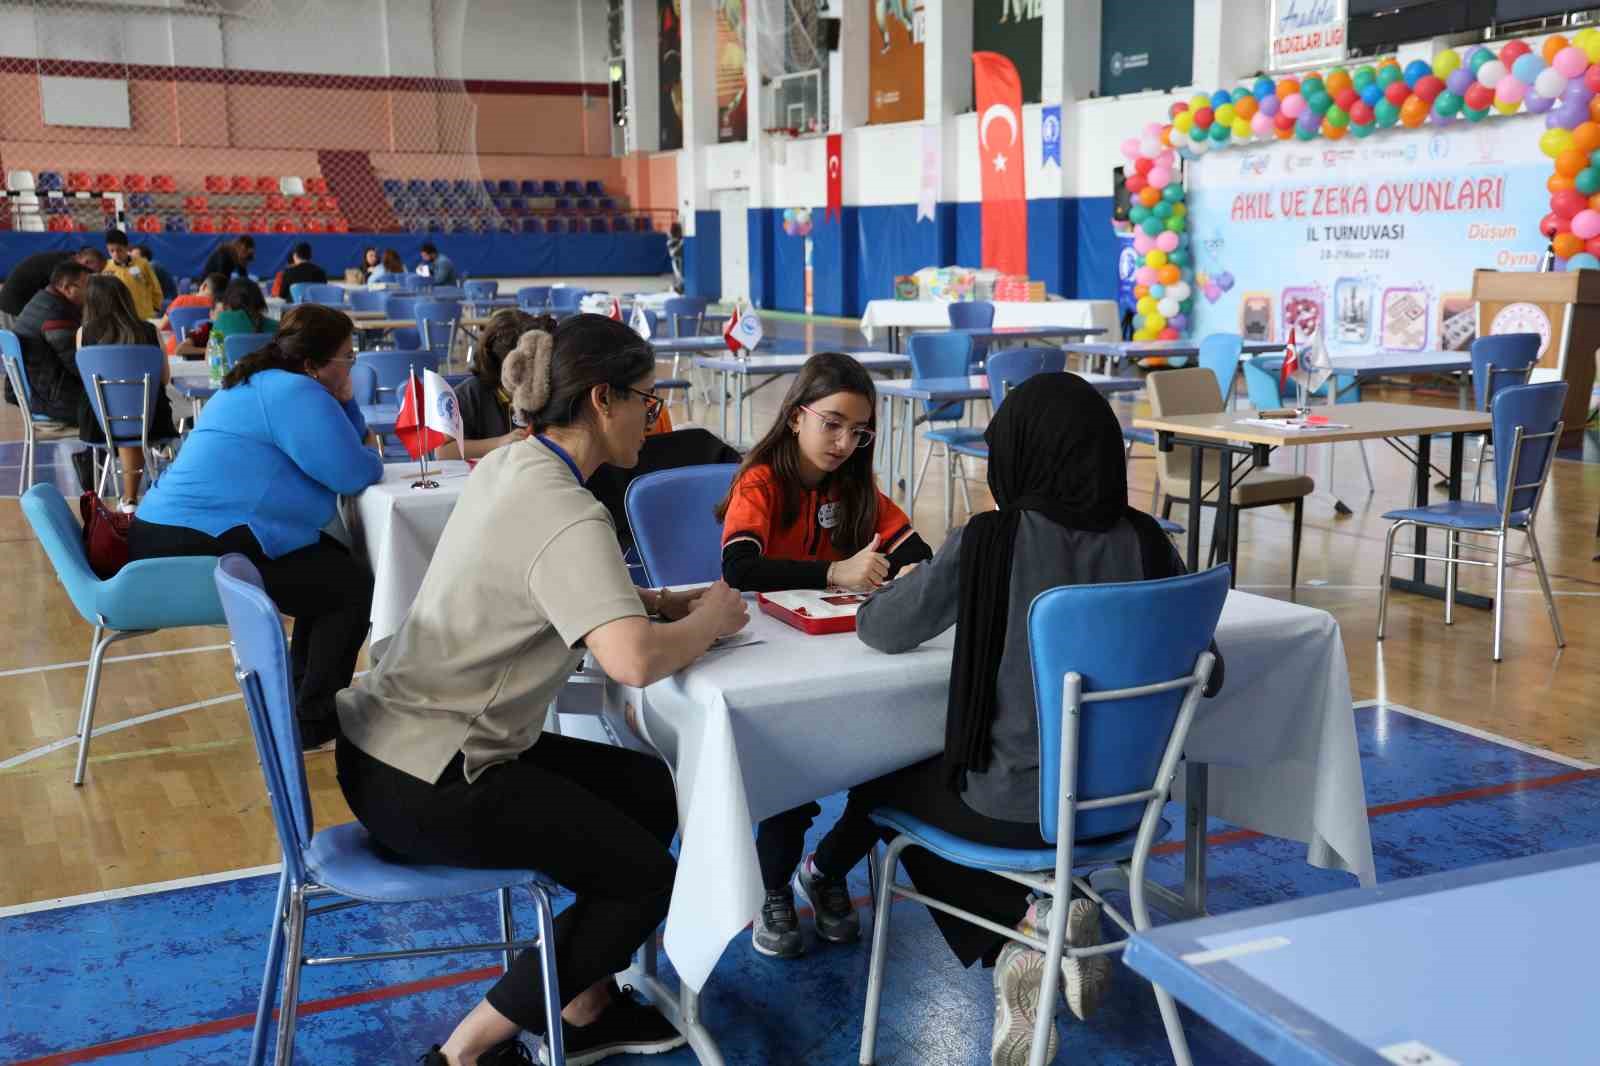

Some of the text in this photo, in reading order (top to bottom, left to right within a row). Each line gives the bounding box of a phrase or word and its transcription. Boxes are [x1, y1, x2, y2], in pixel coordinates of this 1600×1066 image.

[1232, 176, 1503, 221] AKIL VE ZEKA OYUNLARI
[1325, 223, 1405, 241] TURNUVASI
